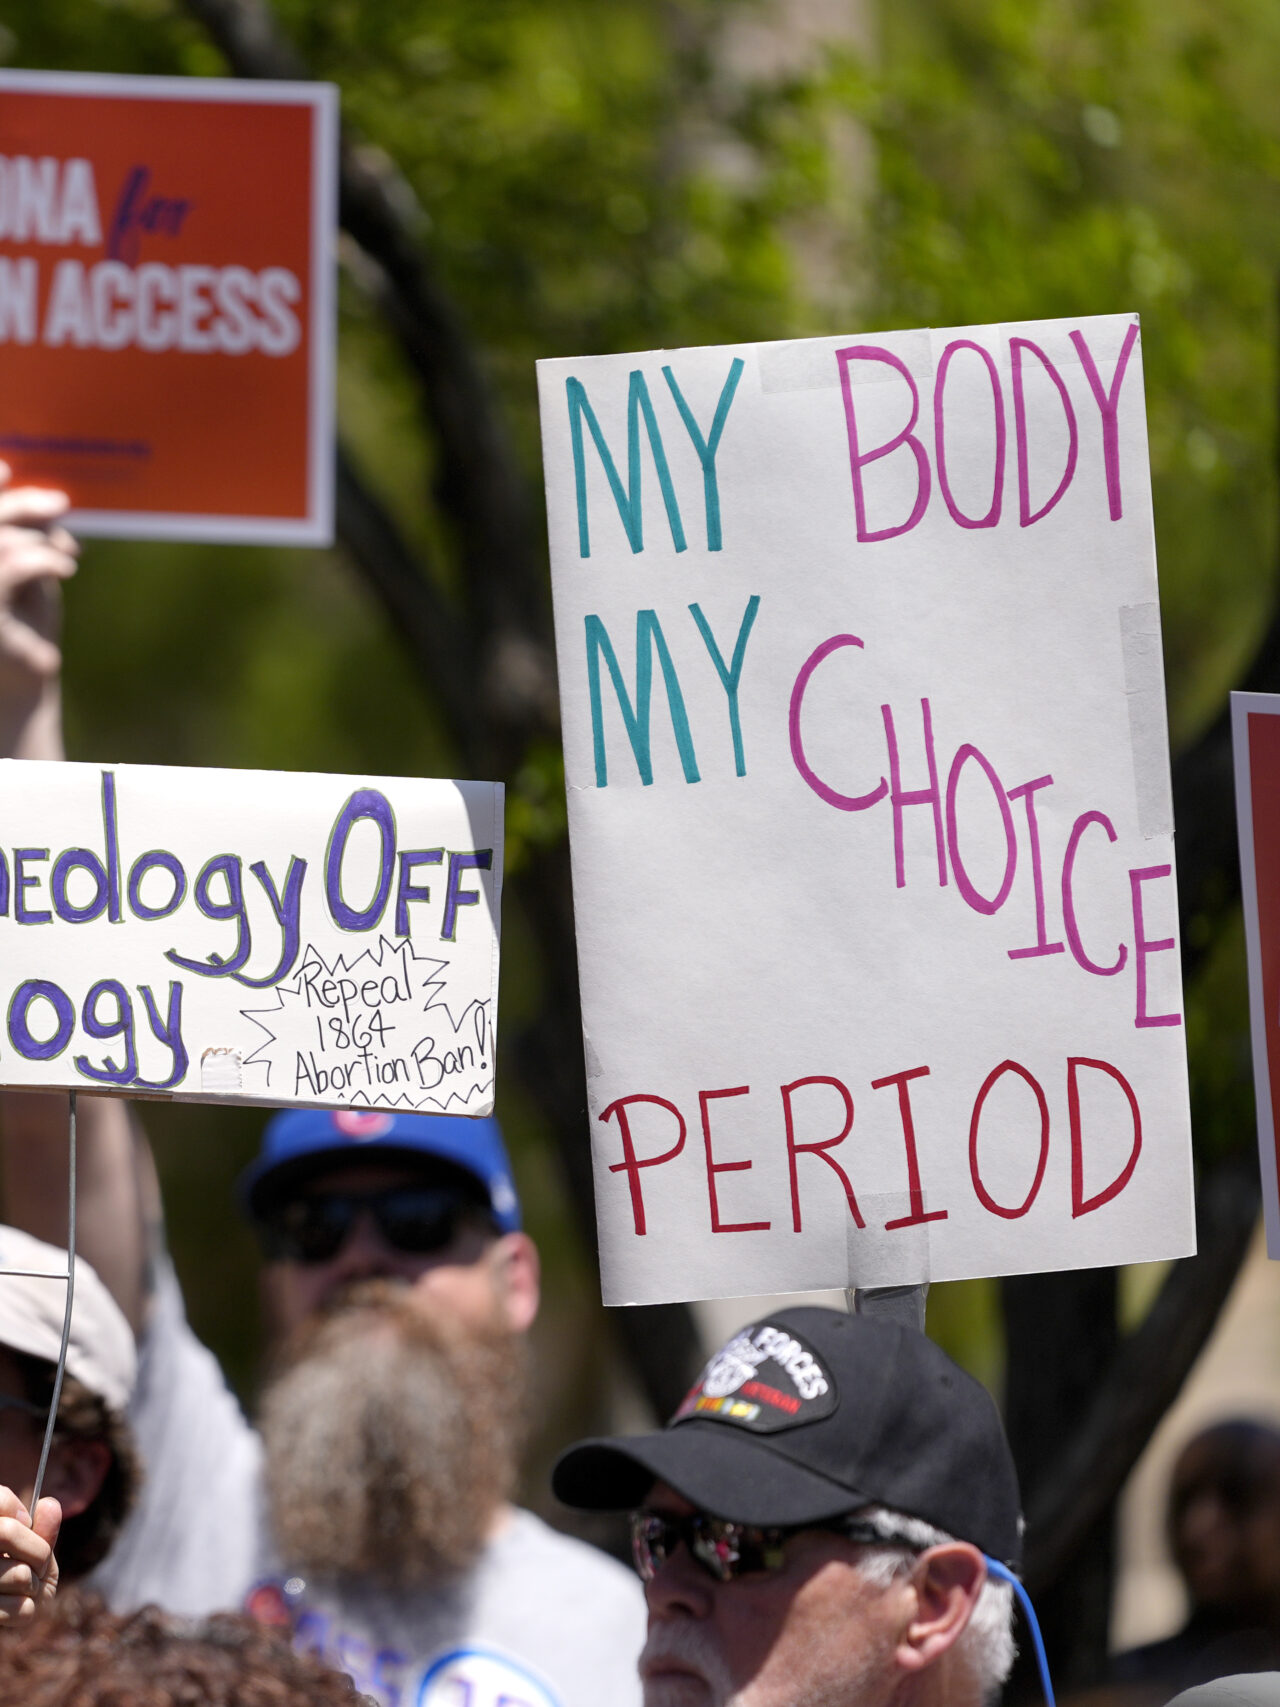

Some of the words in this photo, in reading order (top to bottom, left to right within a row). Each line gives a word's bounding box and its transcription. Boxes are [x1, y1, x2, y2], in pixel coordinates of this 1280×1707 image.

[107, 164, 195, 262] for
[42, 260, 302, 358] ACCESS
[566, 357, 745, 558] MY
[835, 324, 1140, 543] BODY
[584, 595, 760, 788] MY
[788, 633, 1182, 1028] CHOICE
[324, 787, 493, 941] OFF
[293, 947, 412, 1023] Repeal
[316, 1009, 396, 1056] 1864
[295, 1046, 410, 1096] Abortion
[410, 1006, 488, 1090] Ban!
[598, 1057, 1143, 1237] PERIOD
[753, 1327, 829, 1400] FORCES
